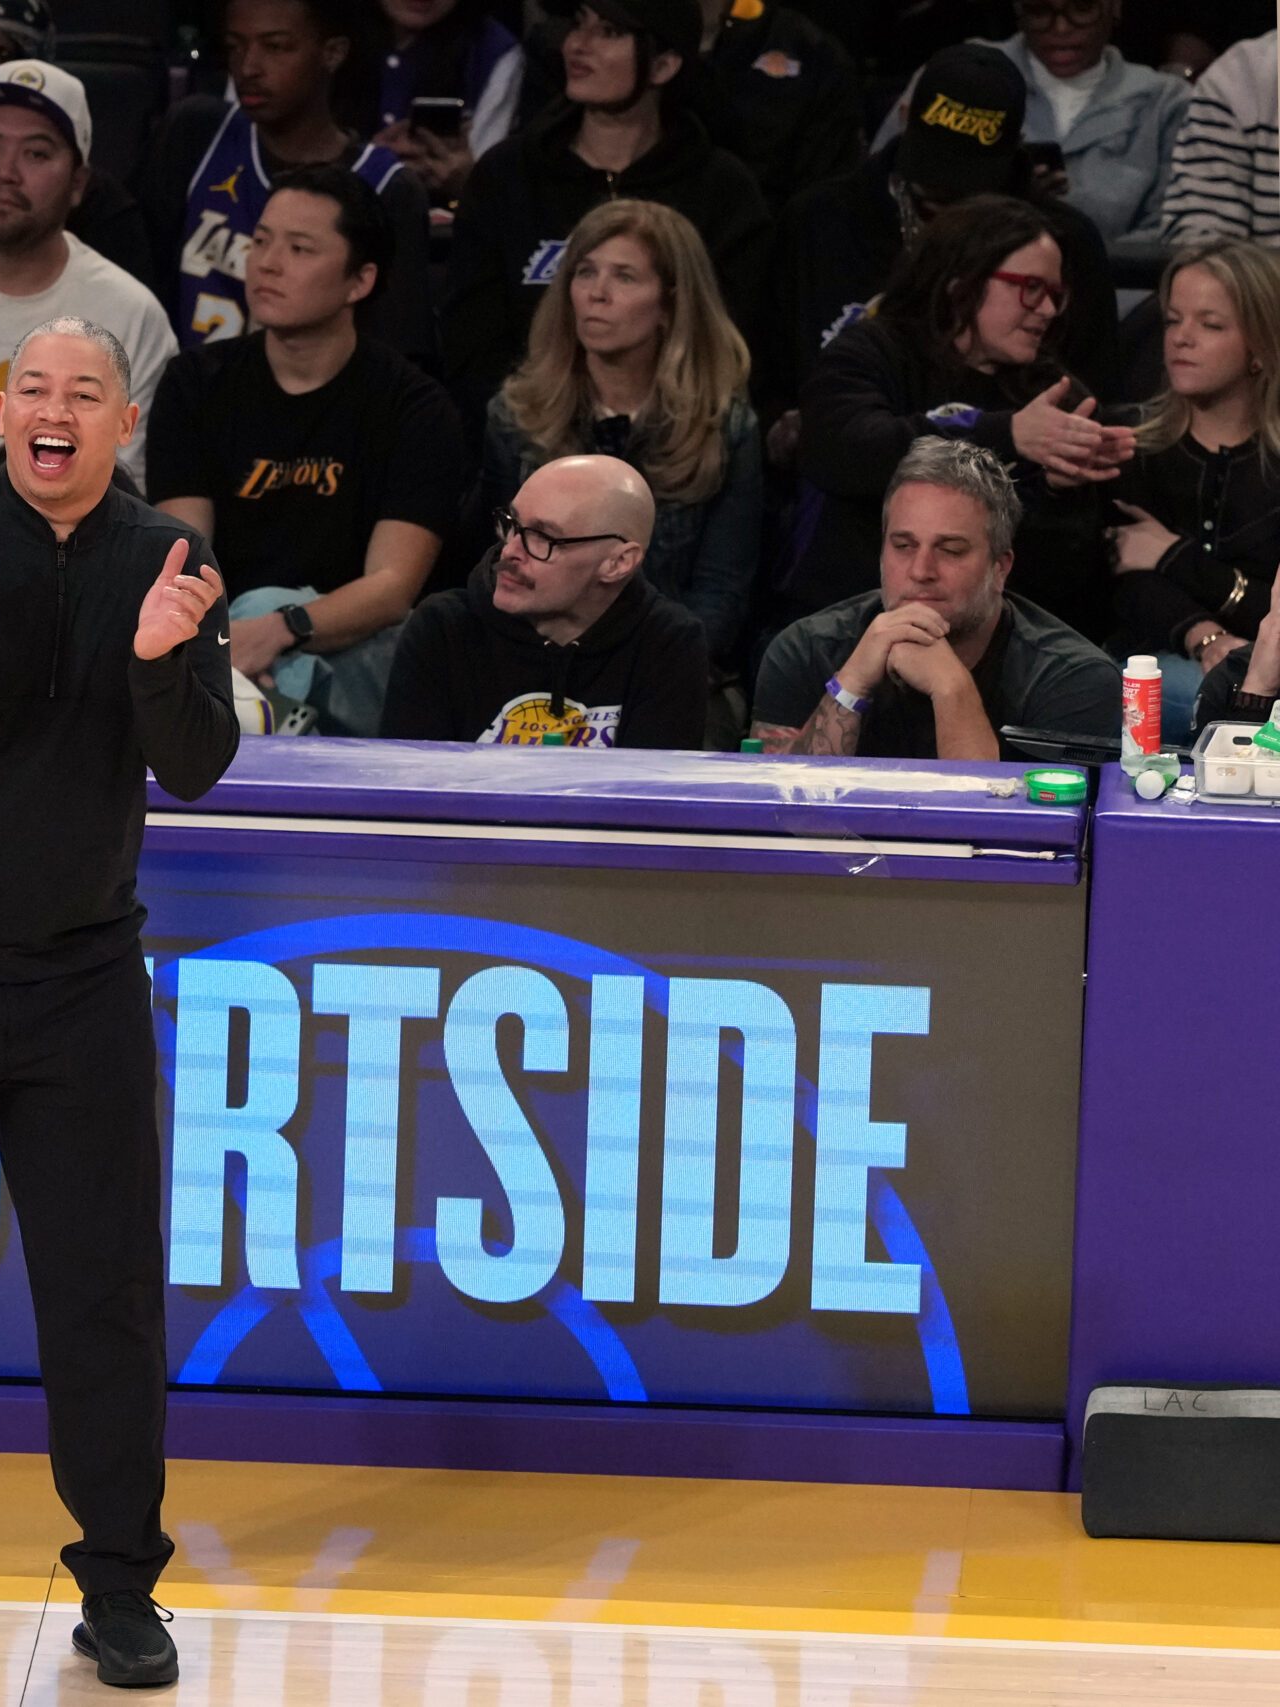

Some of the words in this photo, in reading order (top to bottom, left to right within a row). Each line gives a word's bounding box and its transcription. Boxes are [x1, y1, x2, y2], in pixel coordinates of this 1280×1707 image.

[180, 208, 254, 280] LAK
[520, 721, 549, 732] LOS
[1144, 1390, 1208, 1412] LAC
